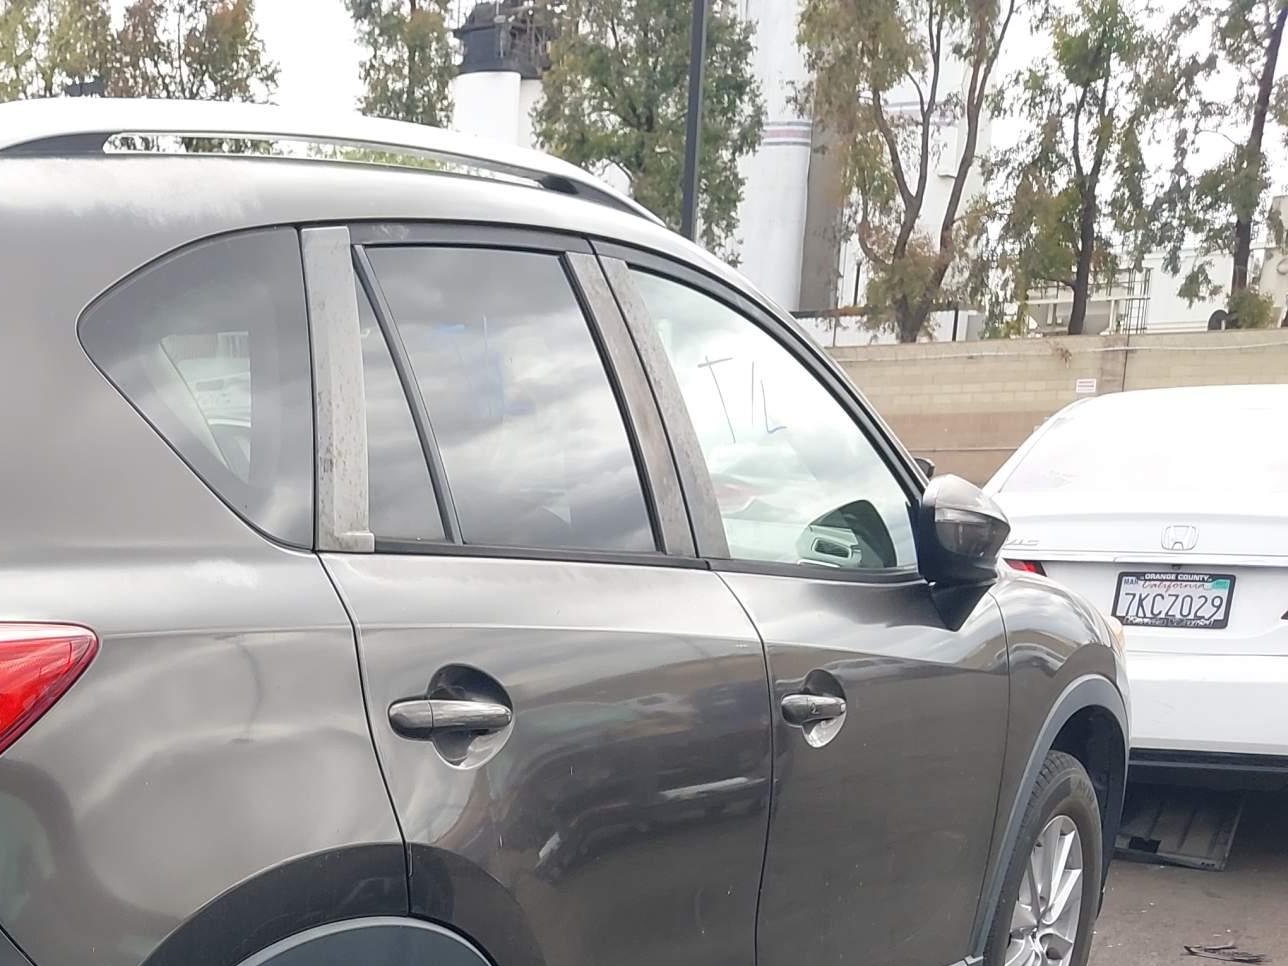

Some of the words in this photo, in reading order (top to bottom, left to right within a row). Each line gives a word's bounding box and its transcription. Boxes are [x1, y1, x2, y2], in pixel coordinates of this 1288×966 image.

[1144, 573, 1177, 581] ORANGE
[1178, 574, 1210, 582] COUNTY
[1142, 581, 1212, 593] California
[1124, 592, 1224, 621] 7KCZ029
